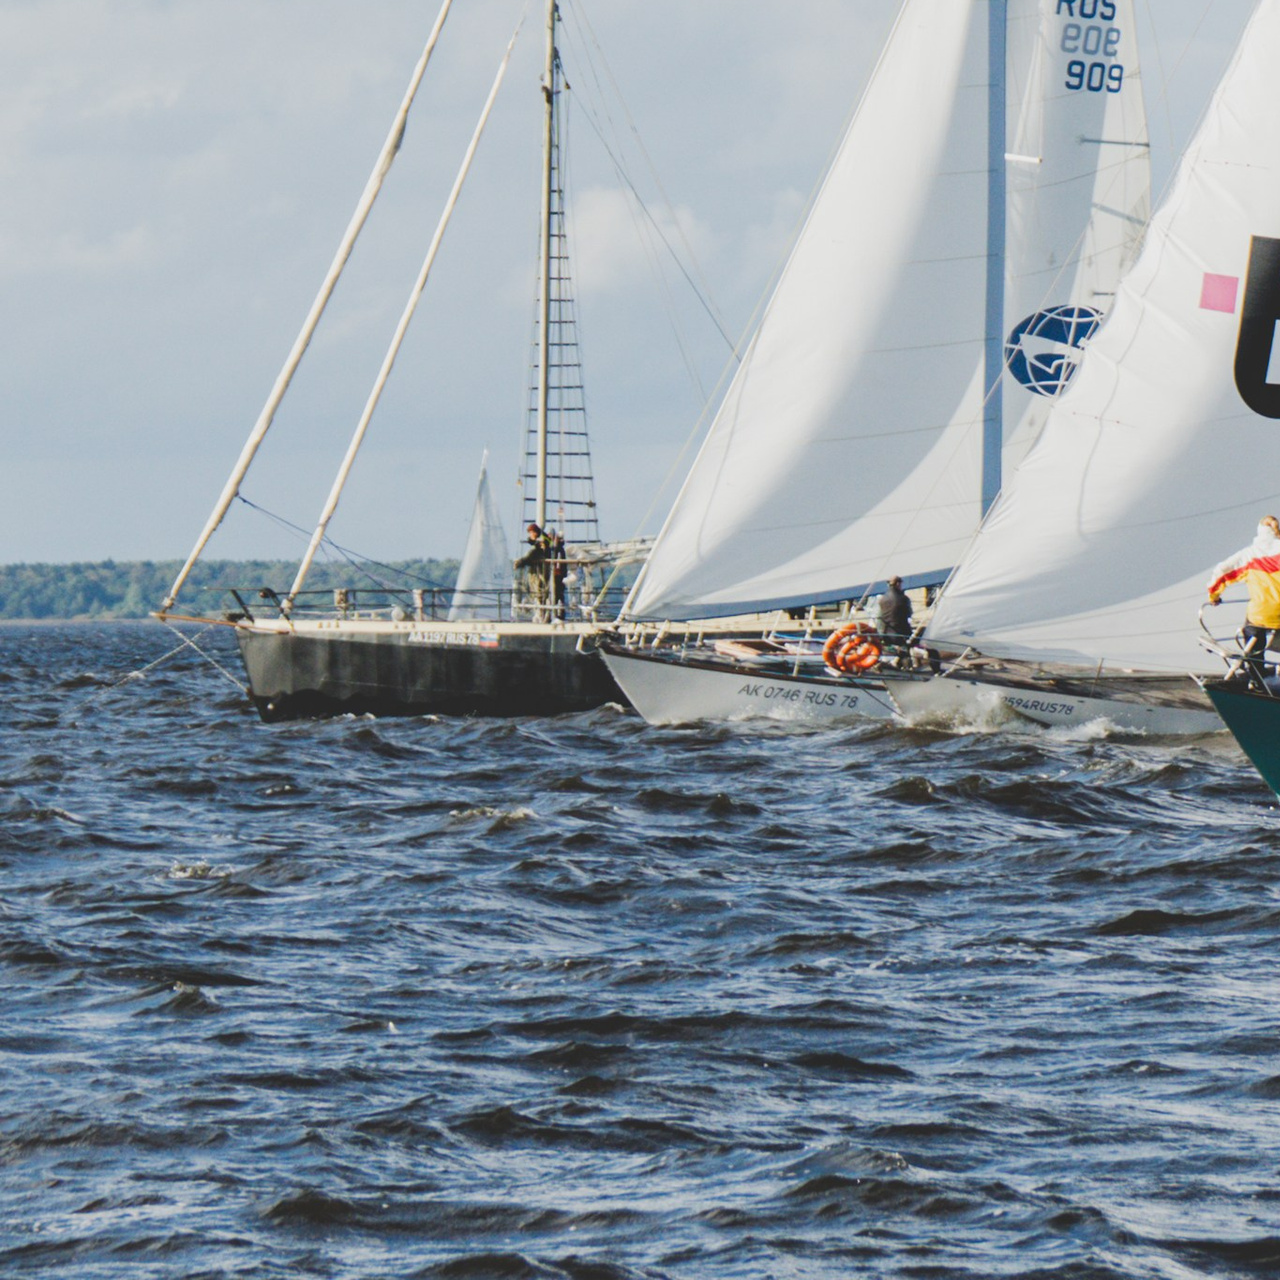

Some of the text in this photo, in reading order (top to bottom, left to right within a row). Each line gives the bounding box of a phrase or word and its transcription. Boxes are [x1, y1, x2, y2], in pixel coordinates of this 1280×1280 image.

[1065, 59, 1124, 94] 909
[804, 690, 838, 706] RUS
[840, 695, 859, 709] 78
